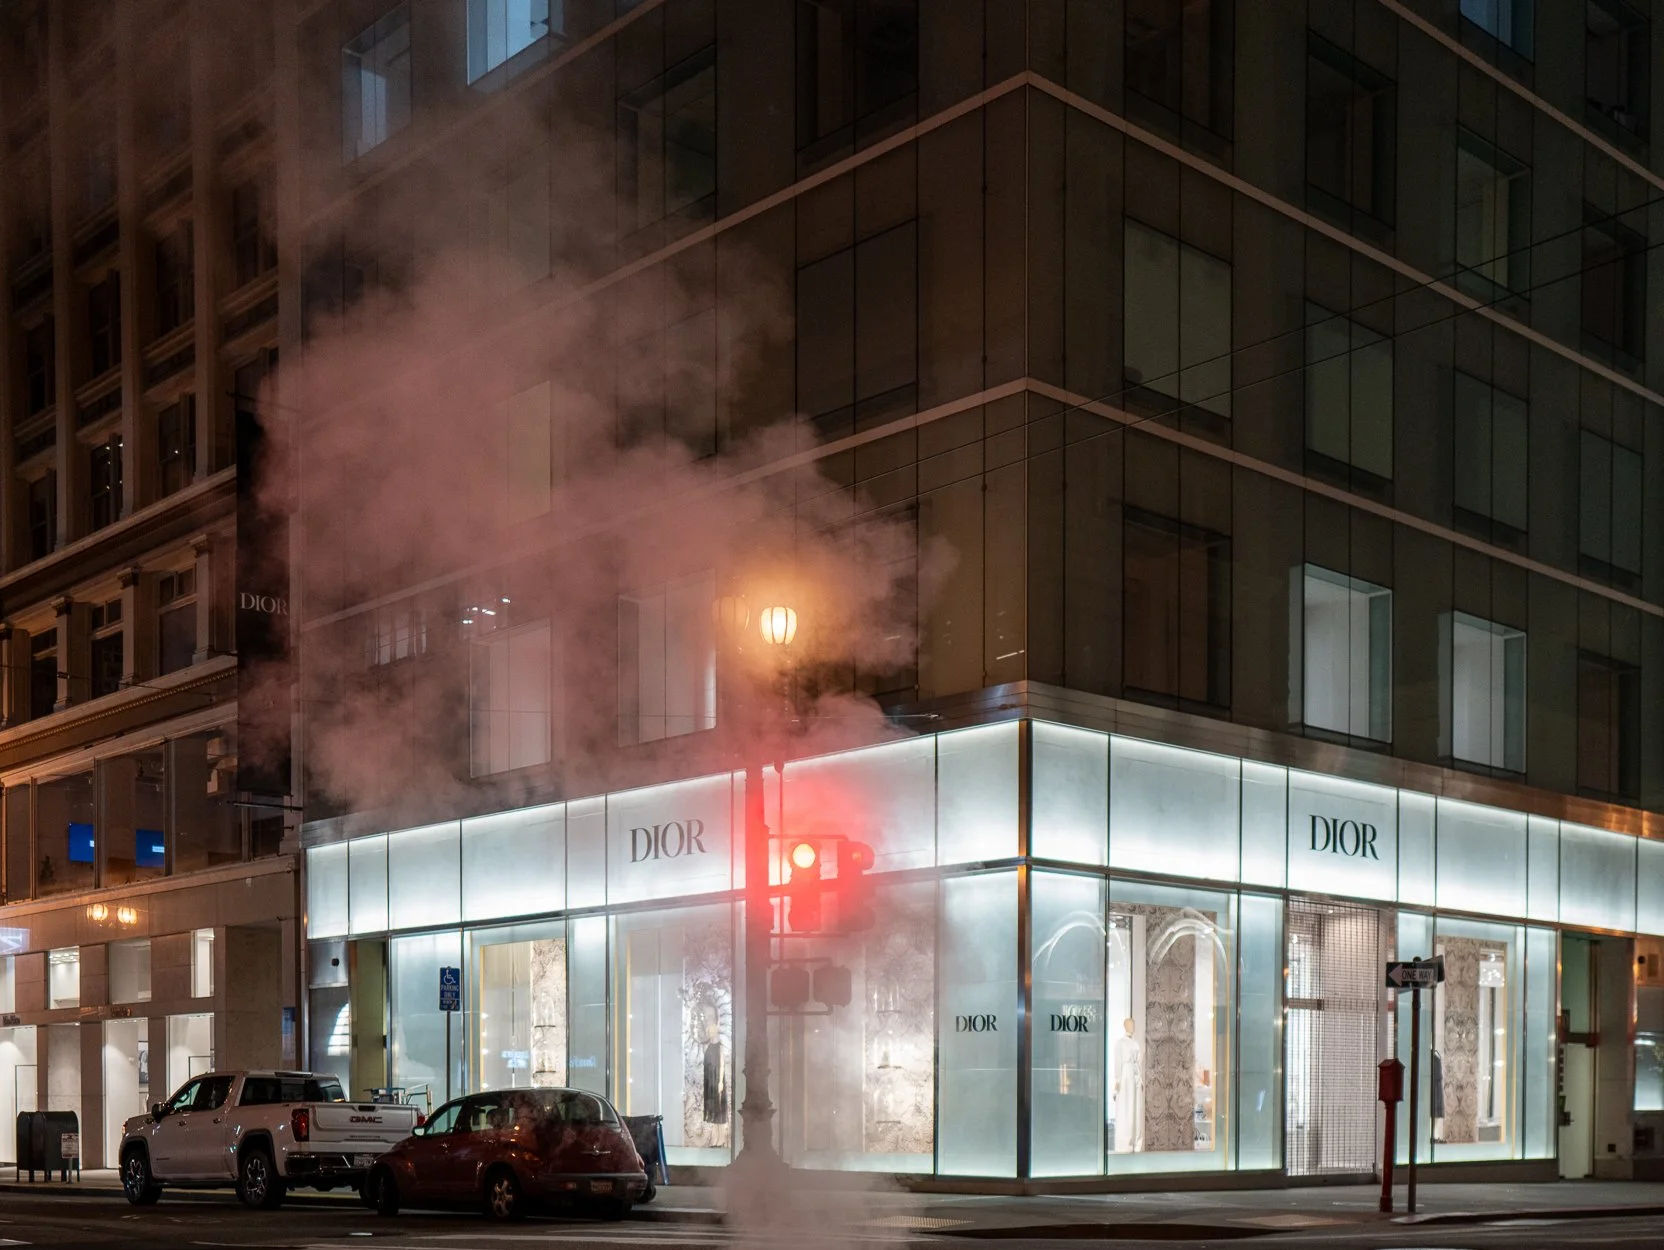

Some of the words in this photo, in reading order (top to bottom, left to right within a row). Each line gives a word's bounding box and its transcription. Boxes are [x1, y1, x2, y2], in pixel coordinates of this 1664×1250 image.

[240, 592, 288, 615] DIOR
[629, 818, 708, 863] DIOR
[1309, 814, 1379, 861] DIOR
[1401, 969, 1417, 980] ONE
[1418, 969, 1433, 980] WAY
[955, 1014, 998, 1032] DIOR
[1050, 1014, 1089, 1032] DIOR
